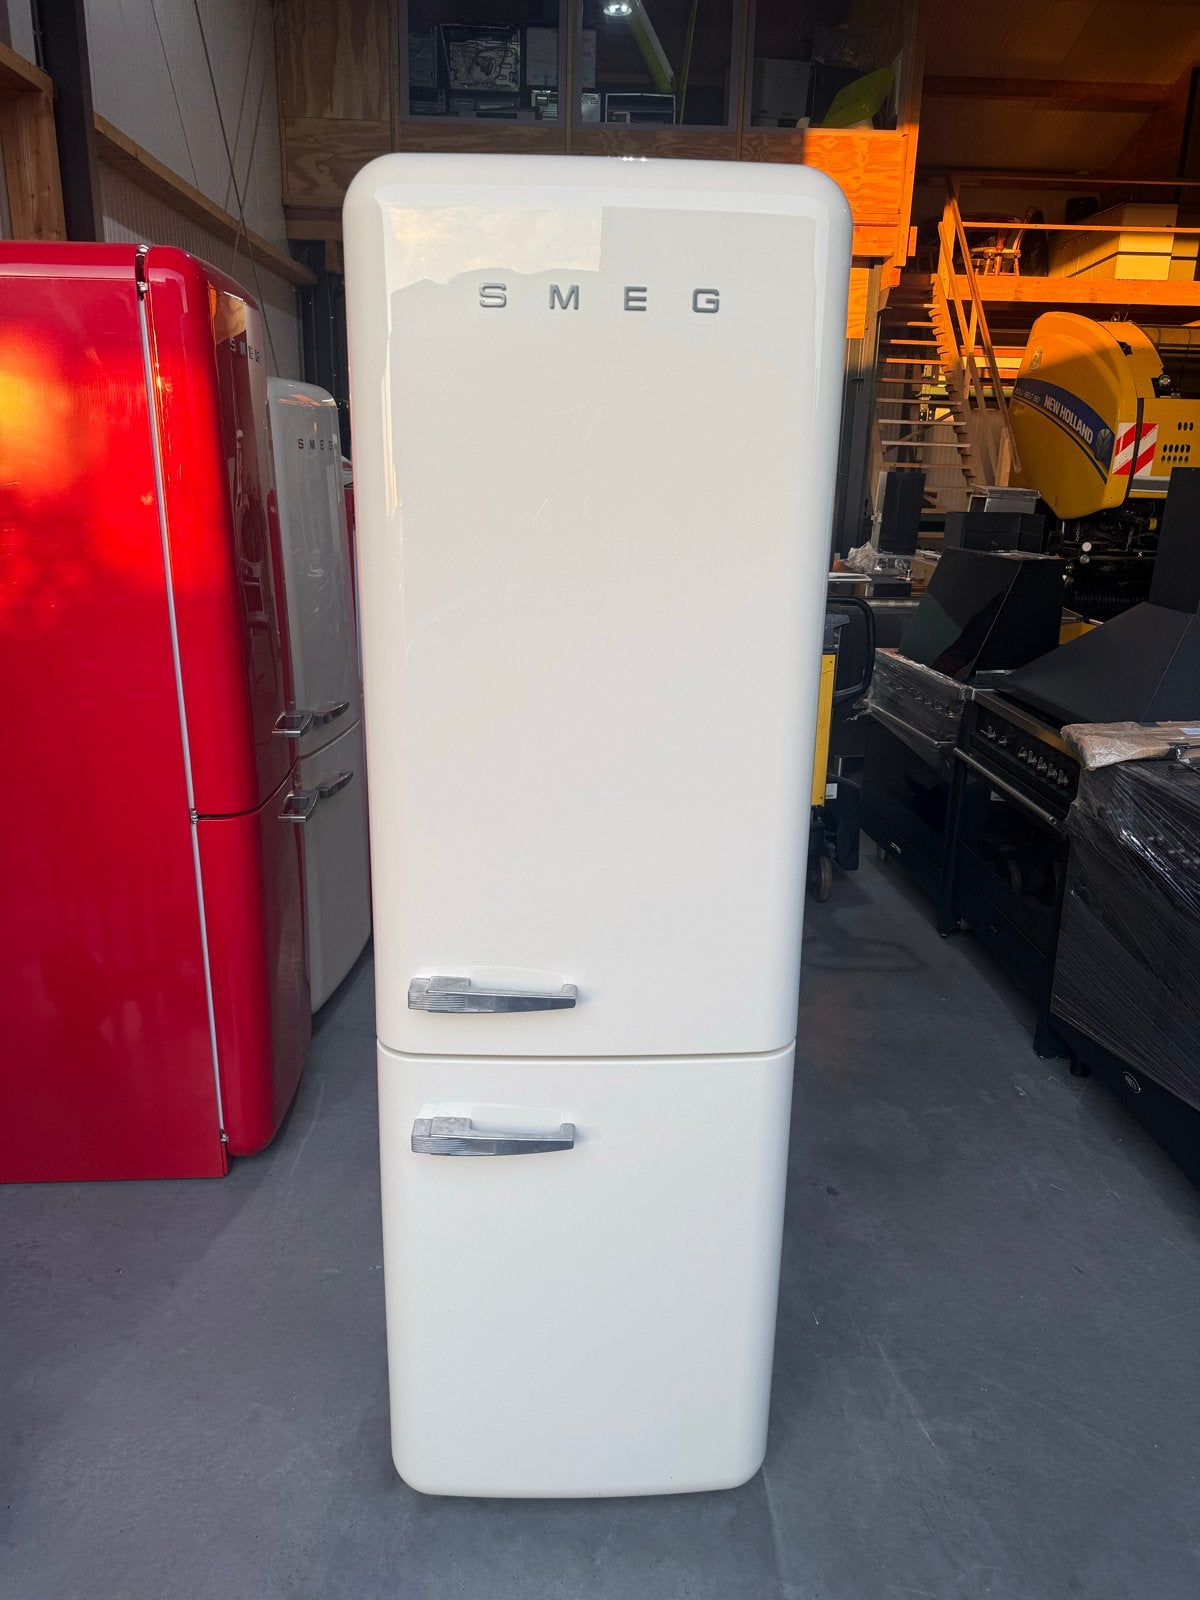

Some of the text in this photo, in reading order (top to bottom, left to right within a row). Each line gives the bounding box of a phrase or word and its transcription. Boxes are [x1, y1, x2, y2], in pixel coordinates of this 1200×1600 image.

[479, 283, 720, 313] SMEG
[1044, 395, 1093, 445] NEW HOLLAND
[297, 438, 333, 451] SMEG
